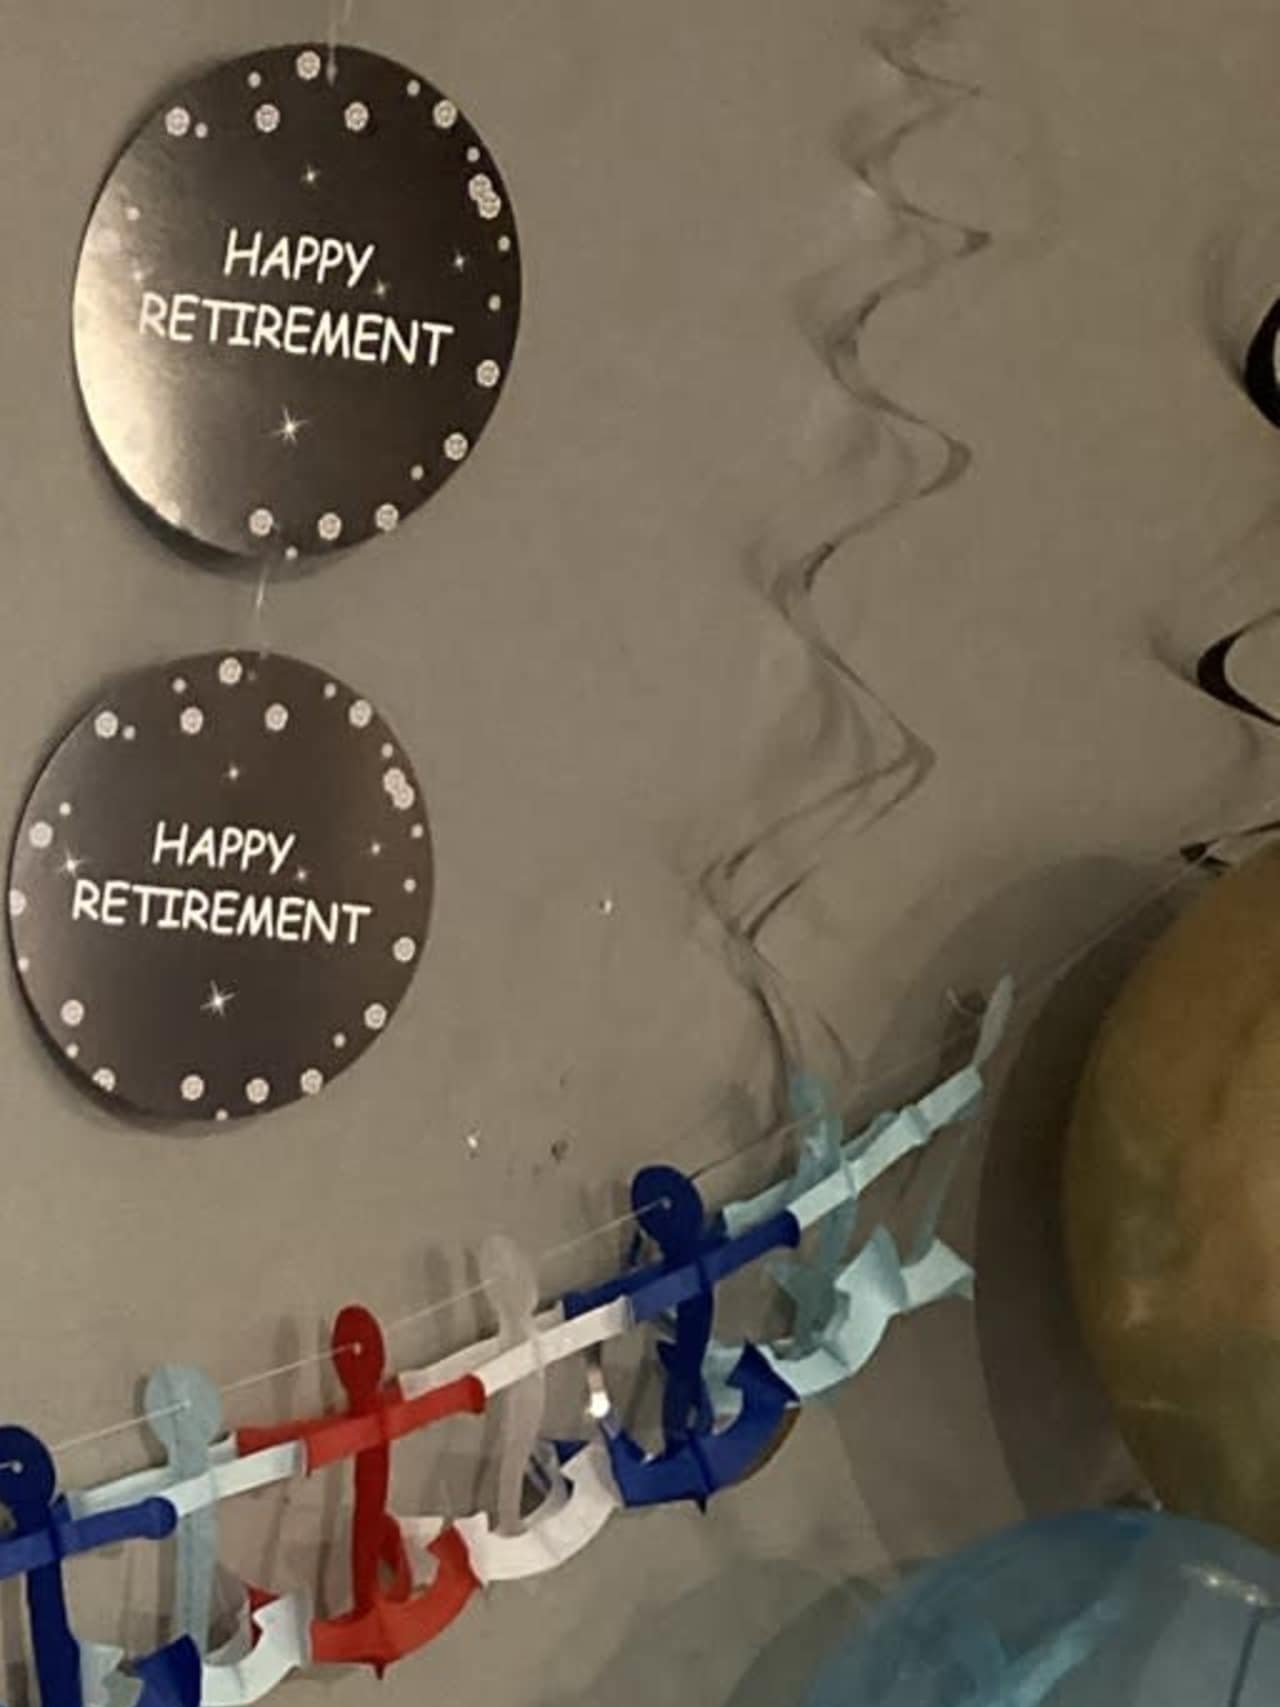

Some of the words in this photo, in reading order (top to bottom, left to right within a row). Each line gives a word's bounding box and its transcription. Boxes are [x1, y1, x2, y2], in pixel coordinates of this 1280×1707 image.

[223, 226, 376, 288] HAPPY
[138, 291, 455, 367] RETIREMENT
[151, 820, 296, 875] HAPPY
[72, 879, 373, 944] RETIREMENT
